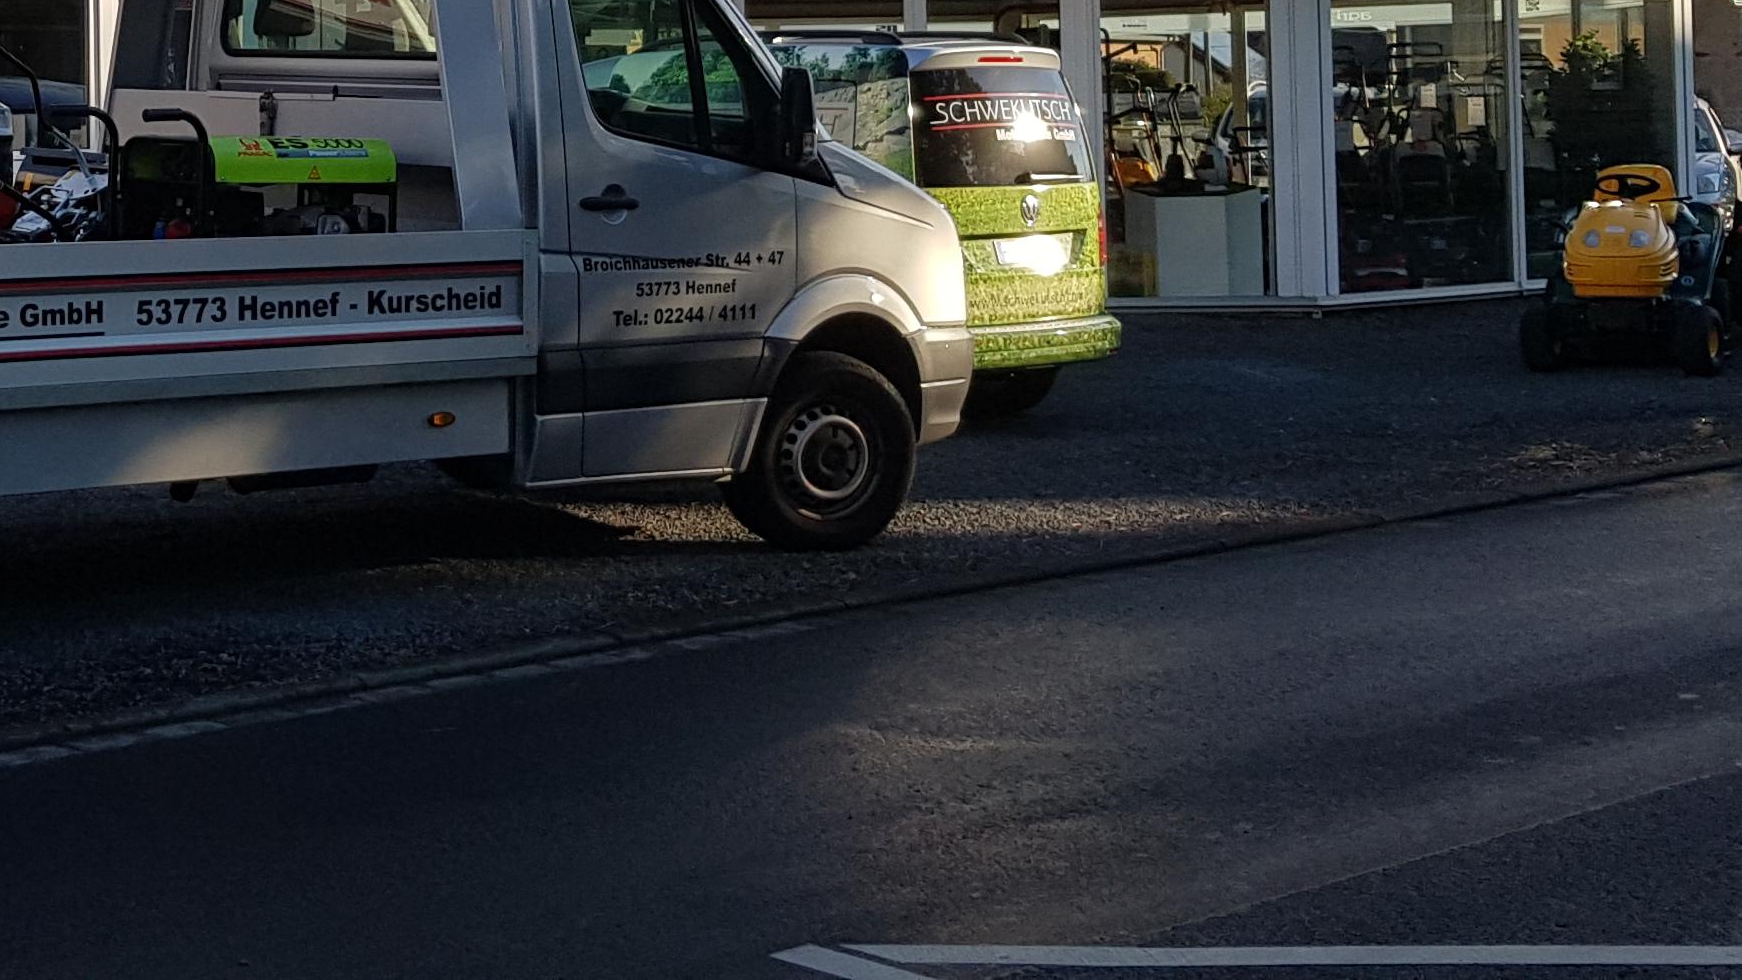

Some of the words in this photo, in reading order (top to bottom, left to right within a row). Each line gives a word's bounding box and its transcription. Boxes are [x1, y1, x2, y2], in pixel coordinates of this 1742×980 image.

[931, 99, 1071, 125] SCHWEKUTSCH
[310, 137, 364, 149] 5000
[582, 255, 702, 273] Broichhausener
[705, 253, 729, 268] Str.
[733, 251, 751, 266] 44
[755, 254, 764, 264] +
[767, 250, 785, 266] 47
[635, 281, 681, 297] 53773
[685, 278, 737, 295] Hennef
[19, 300, 104, 328] GmbH
[136, 296, 228, 327] 53773
[237, 292, 340, 321] Hennef
[366, 284, 502, 315] Kurscheid
[612, 310, 648, 327] Tel.:
[653, 306, 704, 325] 02244
[718, 304, 757, 321] 4111
